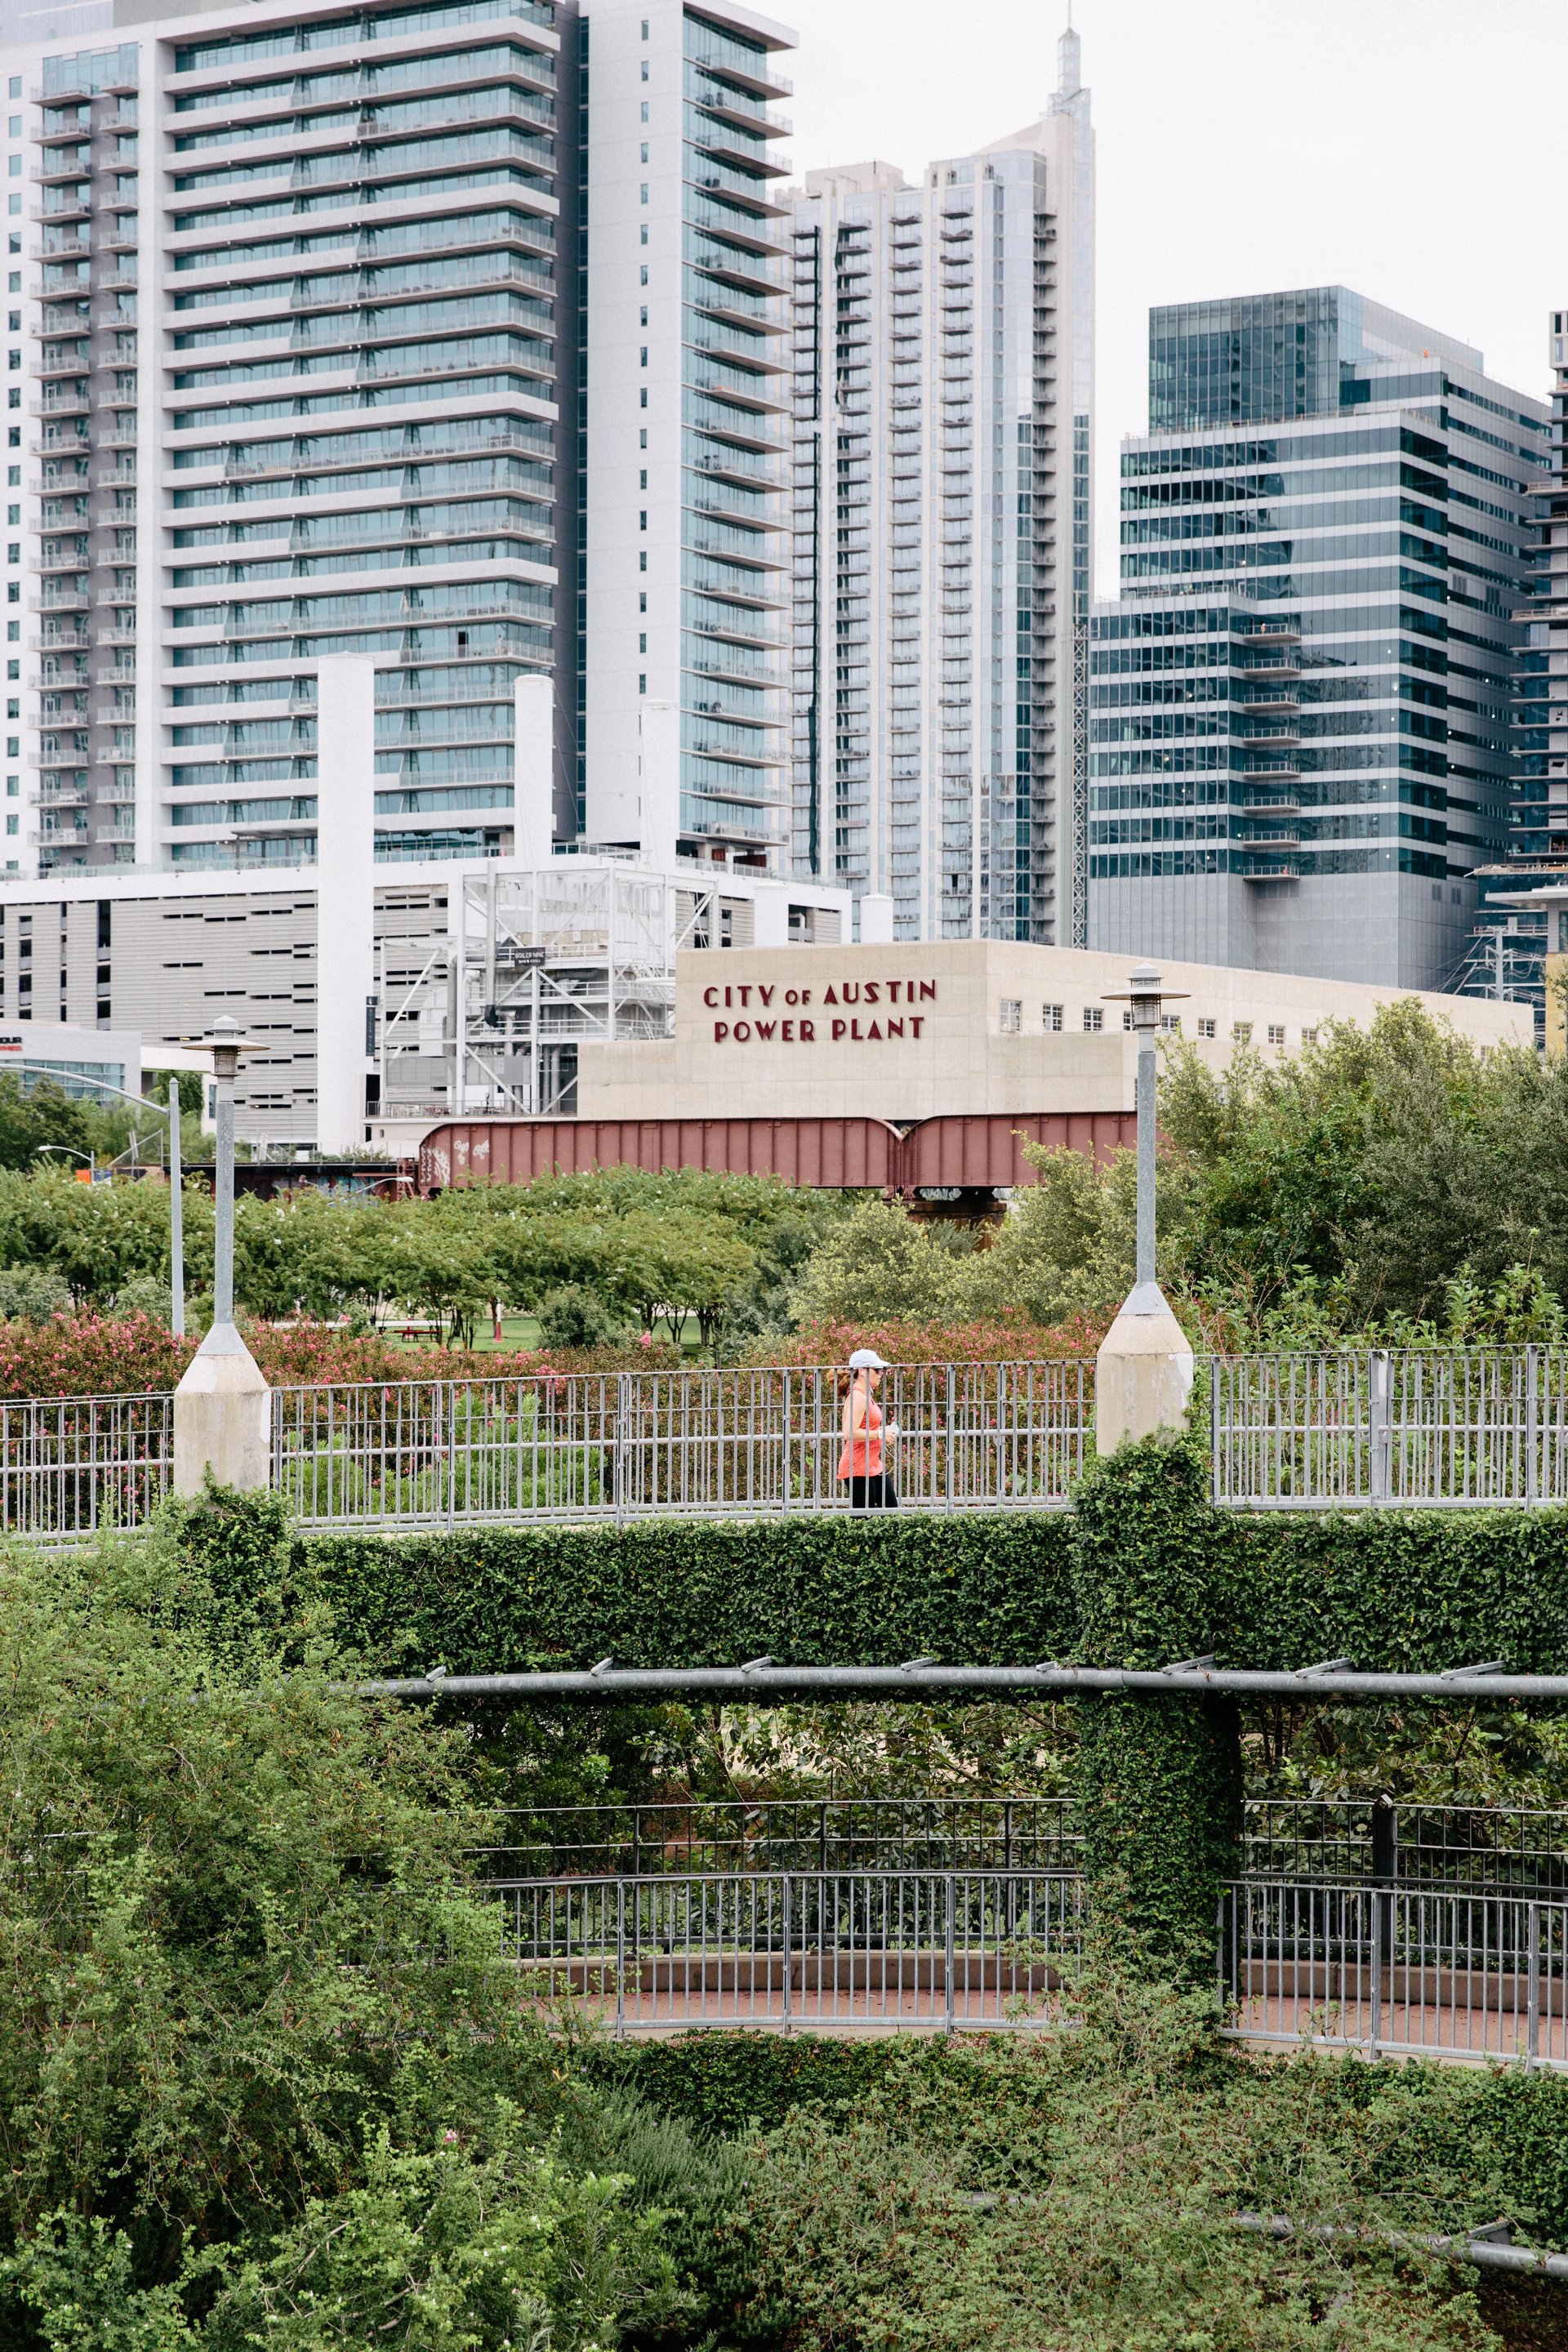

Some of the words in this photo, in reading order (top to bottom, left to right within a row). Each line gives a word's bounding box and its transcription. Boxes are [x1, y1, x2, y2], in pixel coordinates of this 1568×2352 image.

[703, 985, 774, 1008] CITY
[785, 989, 811, 1005] OF
[823, 979, 936, 1004] AUSTIN
[715, 1020, 815, 1043] POWER
[832, 1017, 924, 1040] PLANT
